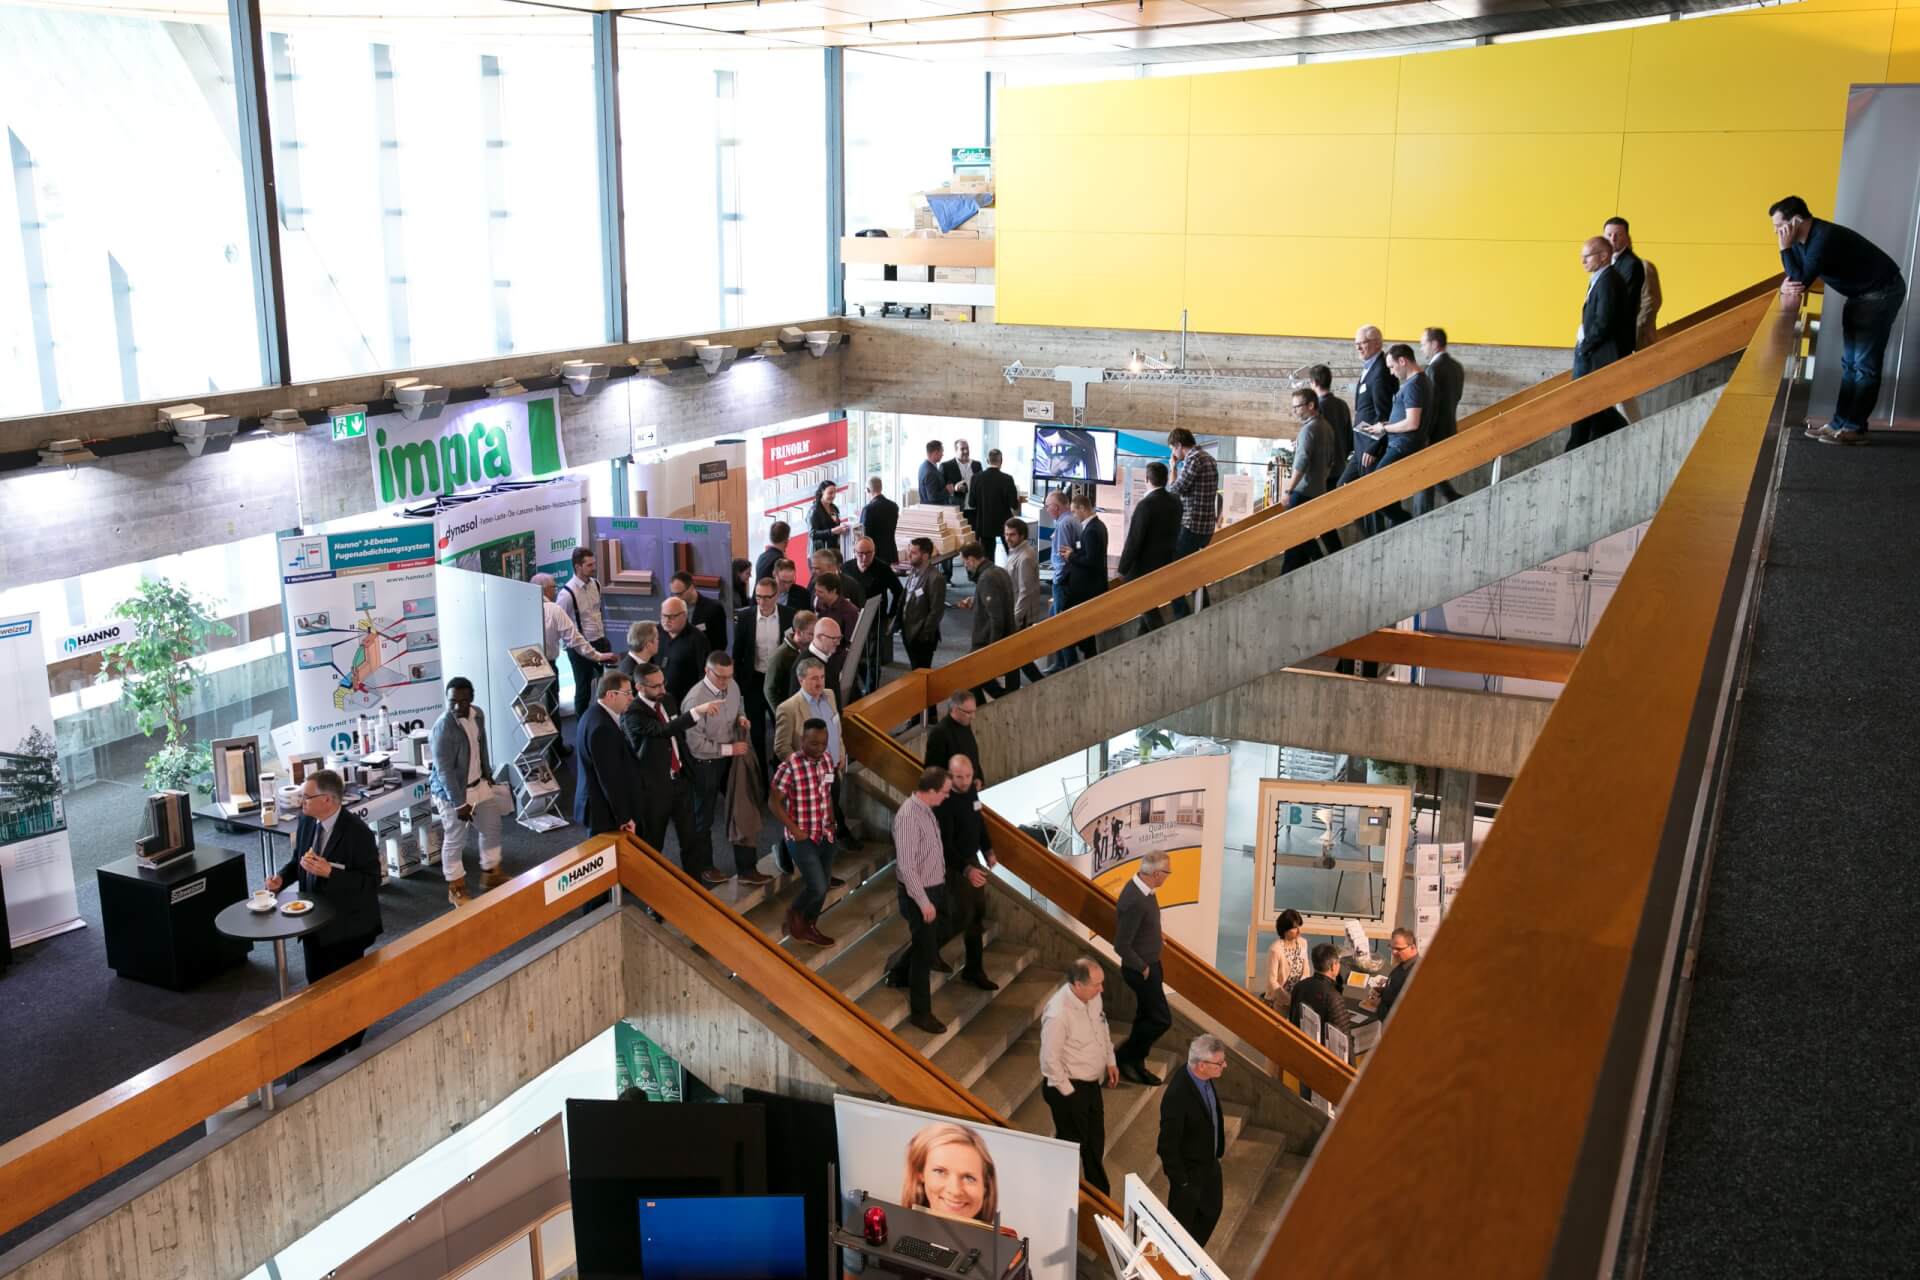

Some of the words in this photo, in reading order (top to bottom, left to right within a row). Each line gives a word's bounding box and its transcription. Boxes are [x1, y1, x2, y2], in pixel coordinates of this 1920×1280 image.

[376, 422, 512, 504] impra
[446, 515, 478, 542] dynasol
[551, 537, 577, 551] impra
[78, 627, 120, 646] HANNO
[308, 722, 334, 732] System
[569, 856, 604, 882] HANNO
